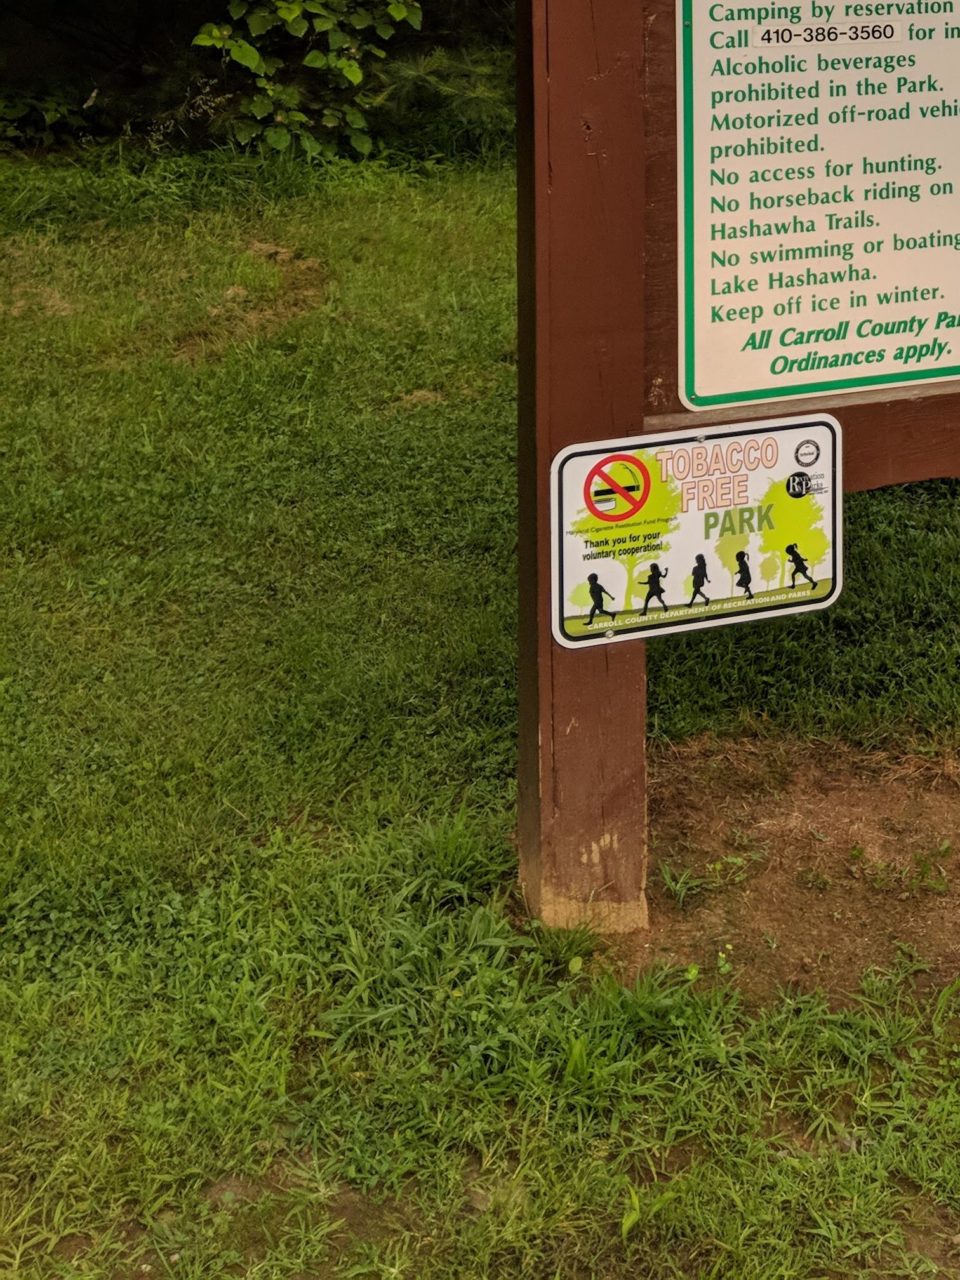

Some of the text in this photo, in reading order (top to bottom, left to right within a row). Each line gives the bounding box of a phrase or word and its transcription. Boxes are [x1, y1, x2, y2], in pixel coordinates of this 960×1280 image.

[710, 29, 748, 49] Call
[761, 24, 894, 44] 410-386-3560
[908, 23, 935, 40] for
[711, 53, 916, 76] Alcoholic beverages
[711, 74, 943, 109] prohibited in the Park.
[711, 107, 818, 131] Motorized
[828, 102, 910, 124] off-road
[710, 134, 824, 164] prohibited.
[710, 154, 942, 186] No access for hunting.
[711, 181, 953, 213] No horseback riding on
[711, 210, 880, 241] Hashawha Trails.
[711, 250, 740, 268] No
[750, 240, 854, 264] swimming
[863, 240, 884, 254] or
[711, 264, 876, 296] Lake Hashawha.
[711, 286, 944, 324] Keep off ice in winter.
[741, 329, 773, 351] All
[779, 321, 850, 347] Carroll
[856, 316, 929, 338] County
[770, 337, 951, 375] Ordinances apply.
[656, 437, 779, 482] TOBACCO
[681, 474, 748, 513] FREE
[704, 504, 776, 540] PARK
[582, 541, 663, 561] voluntary cooperation!
[584, 532, 661, 549] Thank you for your
[587, 589, 811, 630] CARROLL COUNTY DEPARTMENT OF RECREATION AND PARKS
